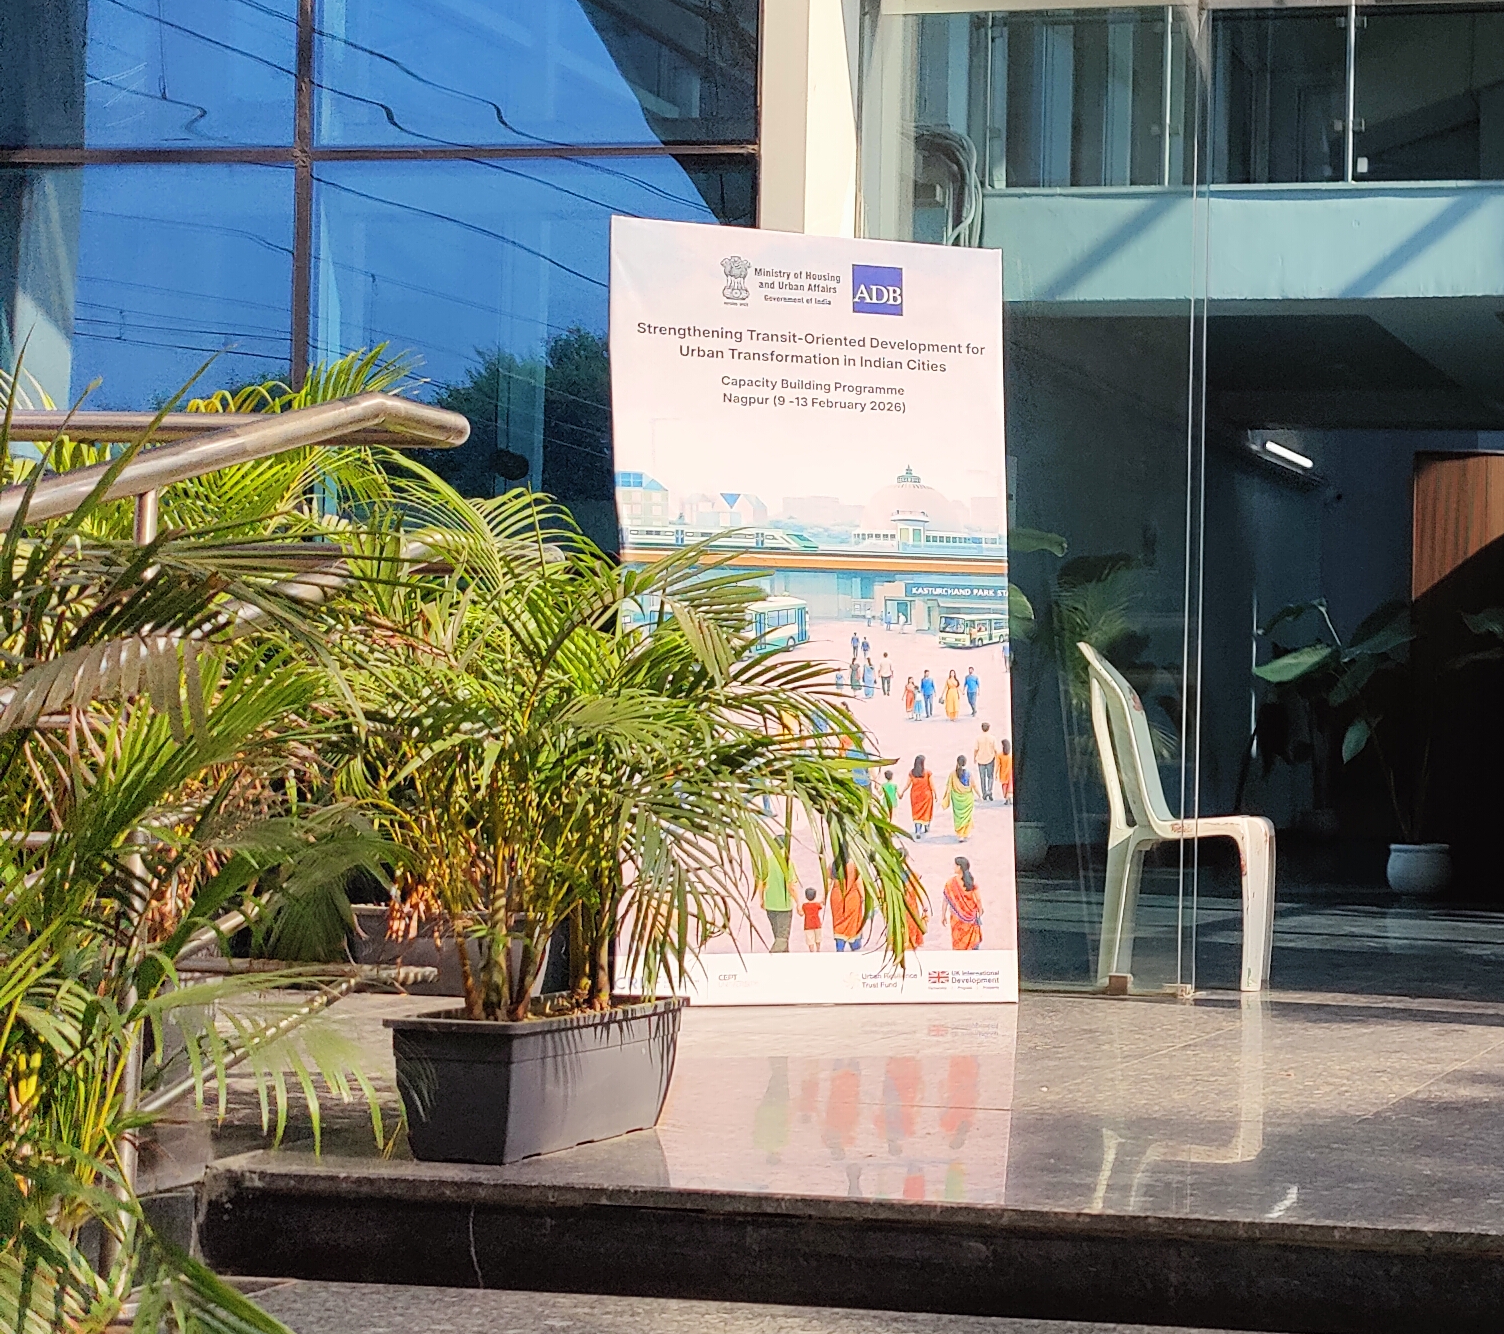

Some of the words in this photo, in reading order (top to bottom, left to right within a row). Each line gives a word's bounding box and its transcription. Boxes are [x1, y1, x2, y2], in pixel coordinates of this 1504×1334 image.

[754, 267, 791, 280] Ministry
[793, 270, 802, 279] of
[805, 271, 841, 284] Housing
[758, 281, 775, 290] and
[778, 281, 805, 292] Urban
[807, 283, 837, 294] Affairs
[853, 283, 902, 305] ADB
[637, 322, 743, 342] Strengthening
[746, 329, 867, 349] Transit-Oriented
[870, 337, 963, 354] Development
[965, 343, 985, 356] for
[679, 344, 724, 359] Urban
[728, 347, 840, 366] Transformation
[844, 354, 856, 367] in
[860, 355, 903, 370] Indian
[906, 359, 947, 373] Cities
[721, 375, 778, 391] Capacity
[781, 378, 831, 394] Building
[834, 382, 906, 398] Programme
[723, 392, 770, 407] Nagpur
[773, 394, 786, 407] (9
[789, 396, 808, 407] -13
[811, 397, 867, 413] February
[869, 400, 906, 414] 2026)
[912, 587, 971, 596] KASTURCHAND
[973, 588, 995, 597] PARK
[861, 981, 879, 989] Trust
[880, 981, 898, 989] Fund
[951, 976, 1000, 985] Development
